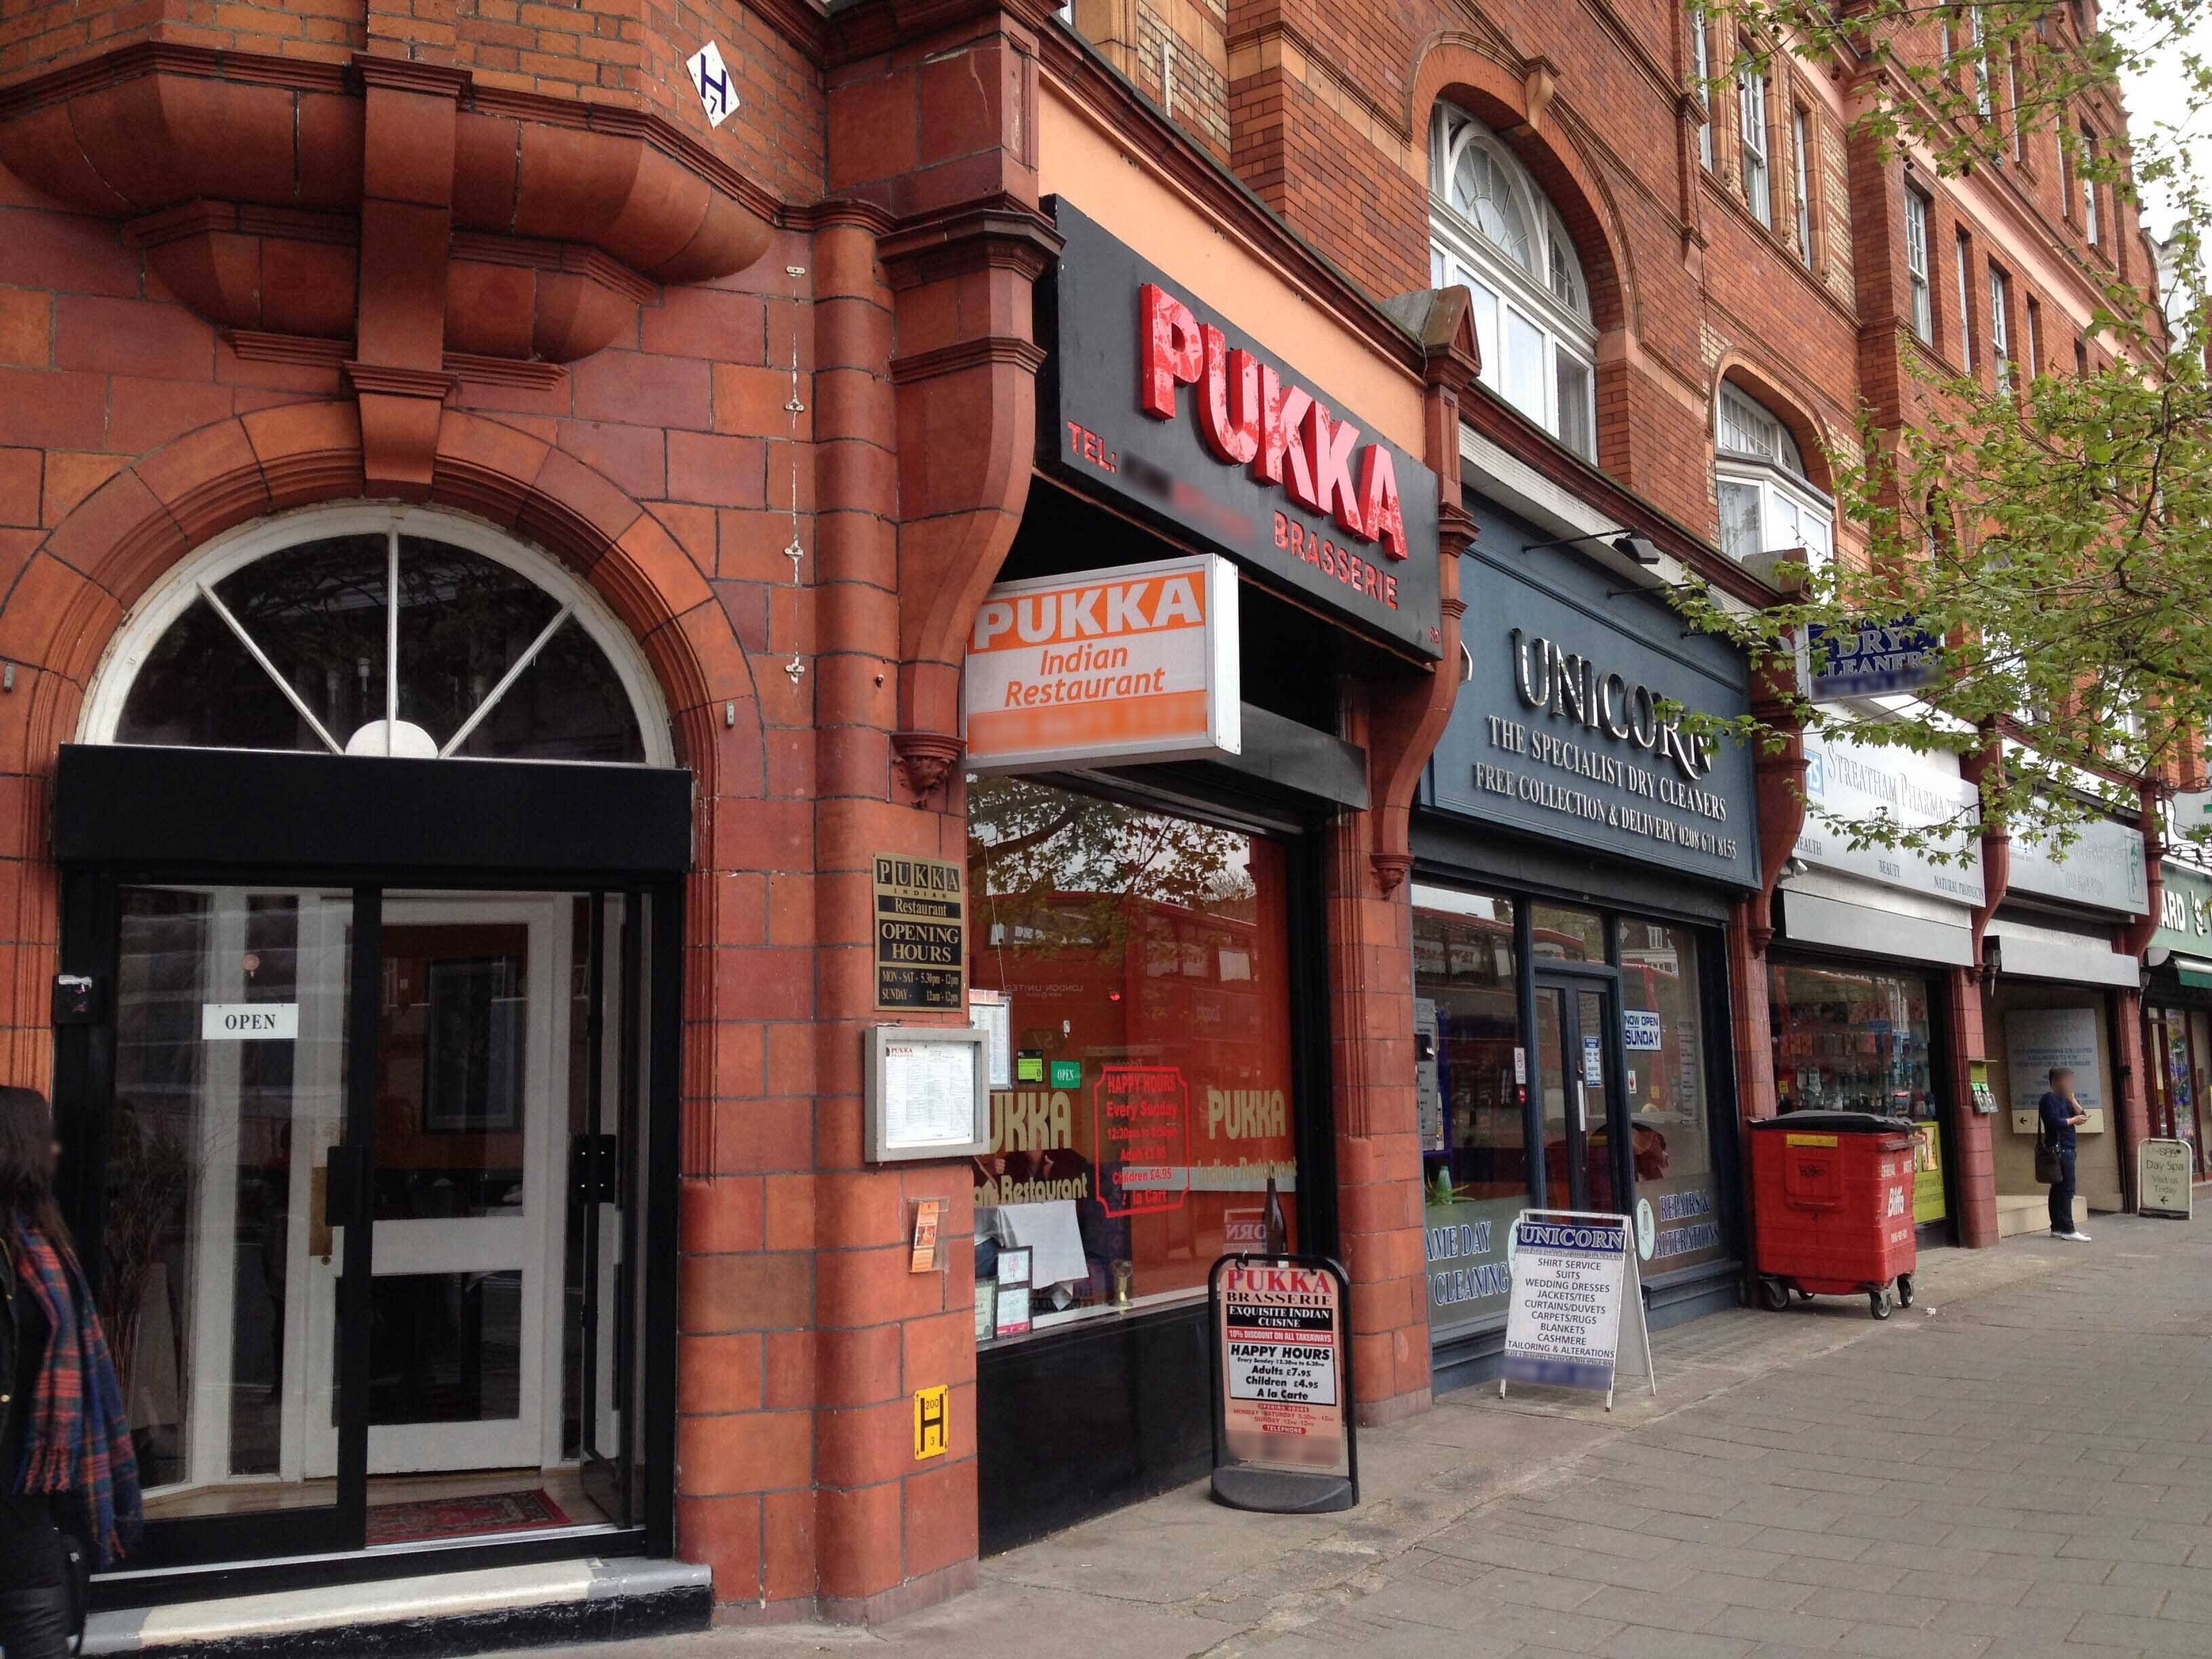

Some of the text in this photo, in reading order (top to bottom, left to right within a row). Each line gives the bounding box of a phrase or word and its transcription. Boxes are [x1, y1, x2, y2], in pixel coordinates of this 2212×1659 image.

[701, 53, 726, 115] H
[710, 95, 717, 115] 7
[1141, 283, 1408, 560] PUKKA
[1067, 419, 1117, 474] TEL:
[1274, 510, 1398, 610] BRASSERIE
[975, 577, 1203, 649] PUKKA
[1040, 642, 1128, 676] Indian
[1818, 650, 1942, 678] LEANERS
[1005, 667, 1165, 708] Restaurant
[1488, 715, 1726, 821] THE SPECIALIST DRY CLEANERS
[1475, 762, 1515, 796] FREE
[1519, 775, 1605, 822] COLLECTION
[1609, 803, 1618, 827] &
[1622, 807, 1677, 842] DELIVERY
[1679, 824, 1699, 848] 0208
[1718, 838, 1738, 859] 8155
[879, 861, 958, 890] PUKKA
[1879, 859, 1900, 879] BEAUTY
[894, 888, 947, 899] INDIAN
[895, 897, 947, 917] Restaurant
[882, 922, 960, 944] OPENING
[891, 943, 951, 962] HOURS
[882, 987, 907, 1000] SUNDAY
[225, 1013, 276, 1030] OPEN
[1626, 1015, 1659, 1026] NOW OPEN
[1626, 1029, 1659, 1046] SUNDAY
[1057, 1068, 1074, 1082] OPEN
[1107, 1073, 1140, 1094] HAPPY
[1106, 1100, 1178, 1122] Every Sunday
[1208, 1089, 1286, 1140] PUKKA
[990, 1091, 1071, 1153] UKKA
[2146, 1160, 2184, 1172] Day Spa
[1001, 1172, 1088, 1206] Restaurant
[1426, 1226, 1458, 1261] AME
[1461, 1221, 1491, 1256] DAY
[1520, 1226, 1624, 1250] UNICORN
[1538, 1258, 1601, 1271] SHIRT SERVICE
[1227, 1269, 1333, 1295] PUKKA
[1556, 1270, 1580, 1280] SUITS
[1434, 1262, 1509, 1307] CLEANING
[1525, 1278, 1610, 1293] WEDDING DRESSES
[1227, 1292, 1332, 1306] BRASSERIE
[1537, 1290, 1595, 1303] JACKETS/TIES
[1229, 1305, 1330, 1319] EXQUISITE INDIAN
[1524, 1300, 1606, 1314] CURTAINS/DUVETS
[1258, 1317, 1300, 1328] CUISINE
[1531, 1311, 1597, 1324] CARPETS/RUGS
[1244, 1330, 1273, 1340] DISCOUNT
[1274, 1332, 1284, 1340] ON
[1284, 1332, 1294, 1340] ALL
[1296, 1333, 1332, 1343] TAKEAWAYS
[1540, 1323, 1585, 1334] BLANKETS
[1537, 1334, 1586, 1345] CASHMERE
[1231, 1345, 1330, 1360] HAPPY HOURS
[1508, 1340, 1550, 1352] TAILORING
[1561, 1346, 1615, 1358] ALTERATIONS
[1252, 1365, 1311, 1377] Adults £7.95
[1246, 1376, 1318, 1389] Children £4.95
[1256, 1389, 1308, 1400] A la Carte
[926, 1399, 939, 1410] 200
[920, 1393, 943, 1452] H
[1267, 1425, 1303, 1434] TELEPHONE
[929, 1436, 935, 1446] 3
